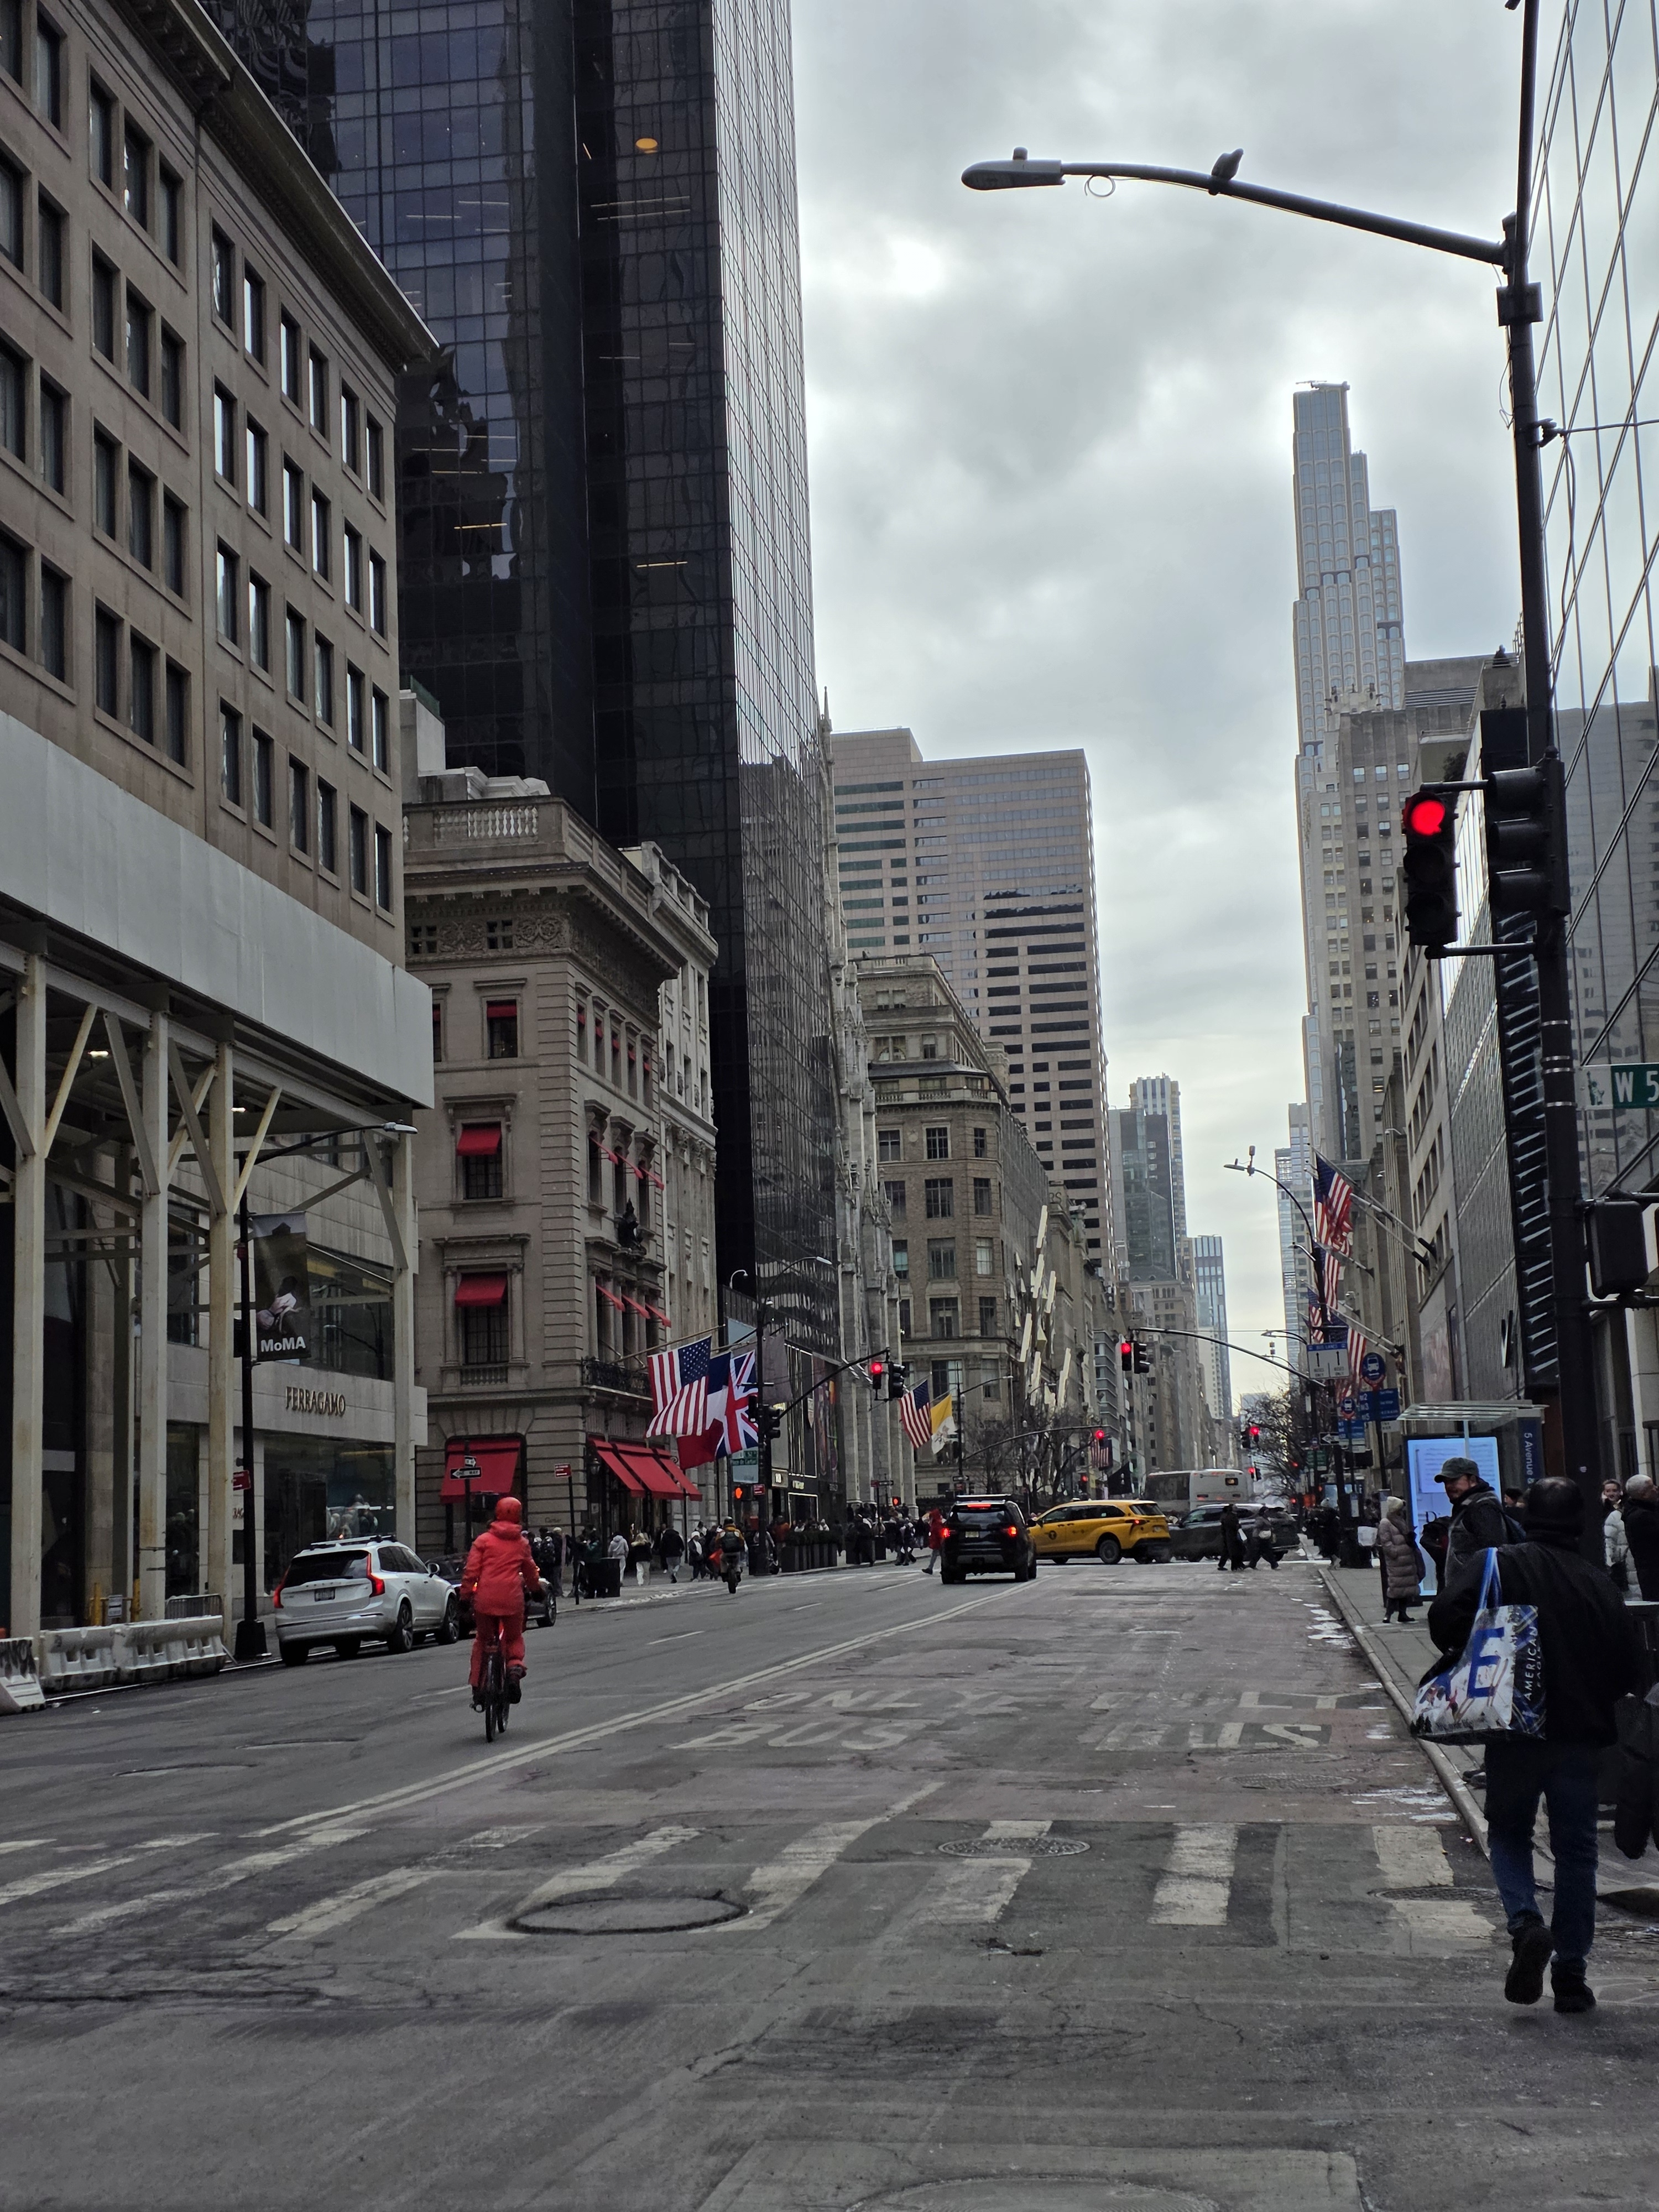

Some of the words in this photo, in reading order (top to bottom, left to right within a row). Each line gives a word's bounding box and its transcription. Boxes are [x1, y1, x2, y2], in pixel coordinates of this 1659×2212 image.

[1615, 1072, 1634, 1102] W
[261, 1336, 306, 1352] MoMA
[285, 1386, 346, 1417] FERRAGAMO
[1525, 1441, 1533, 1475] Avenue
[1524, 1626, 1538, 1700] AMERICAN
[670, 1719, 944, 1750] BUS
